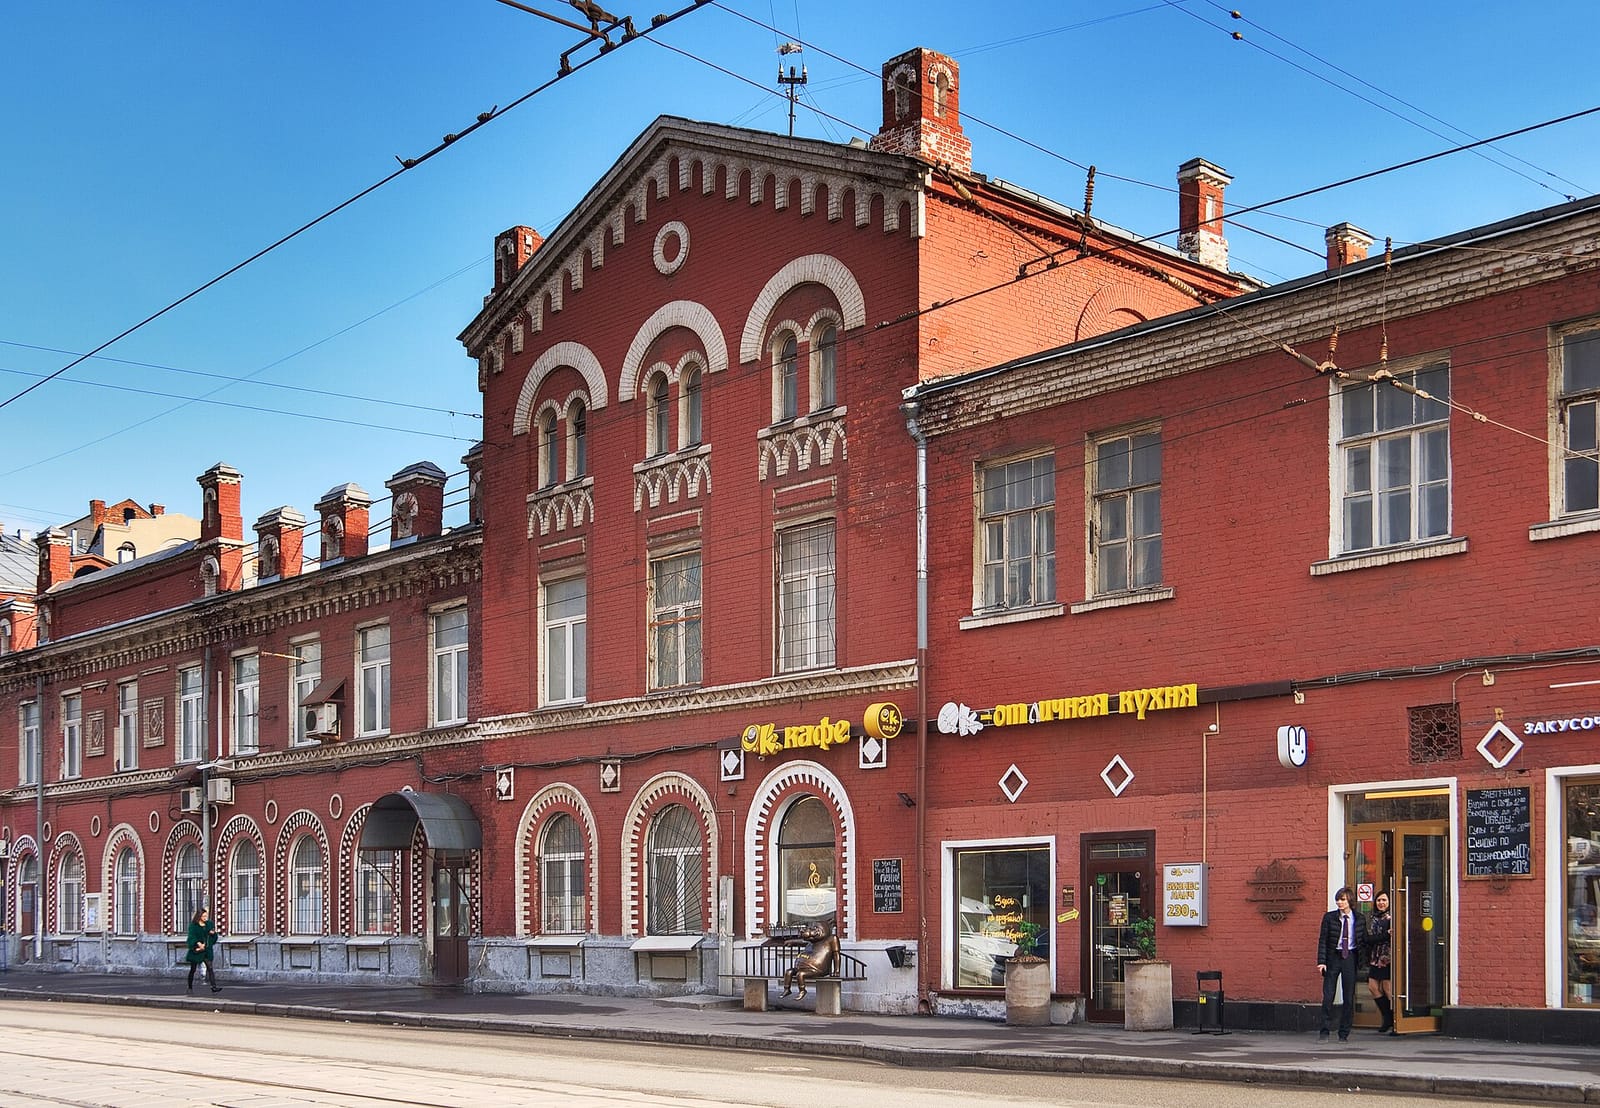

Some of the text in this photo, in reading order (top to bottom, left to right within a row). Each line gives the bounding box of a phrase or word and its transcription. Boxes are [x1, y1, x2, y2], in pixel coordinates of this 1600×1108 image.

[1118, 683, 1198, 721] кухня
[783, 716, 851, 751] кафе
[1166, 881, 1200, 891] БИЗНЕС
[1170, 890, 1195, 900] ЛАНЧ
[1167, 904, 1189, 917] 230
